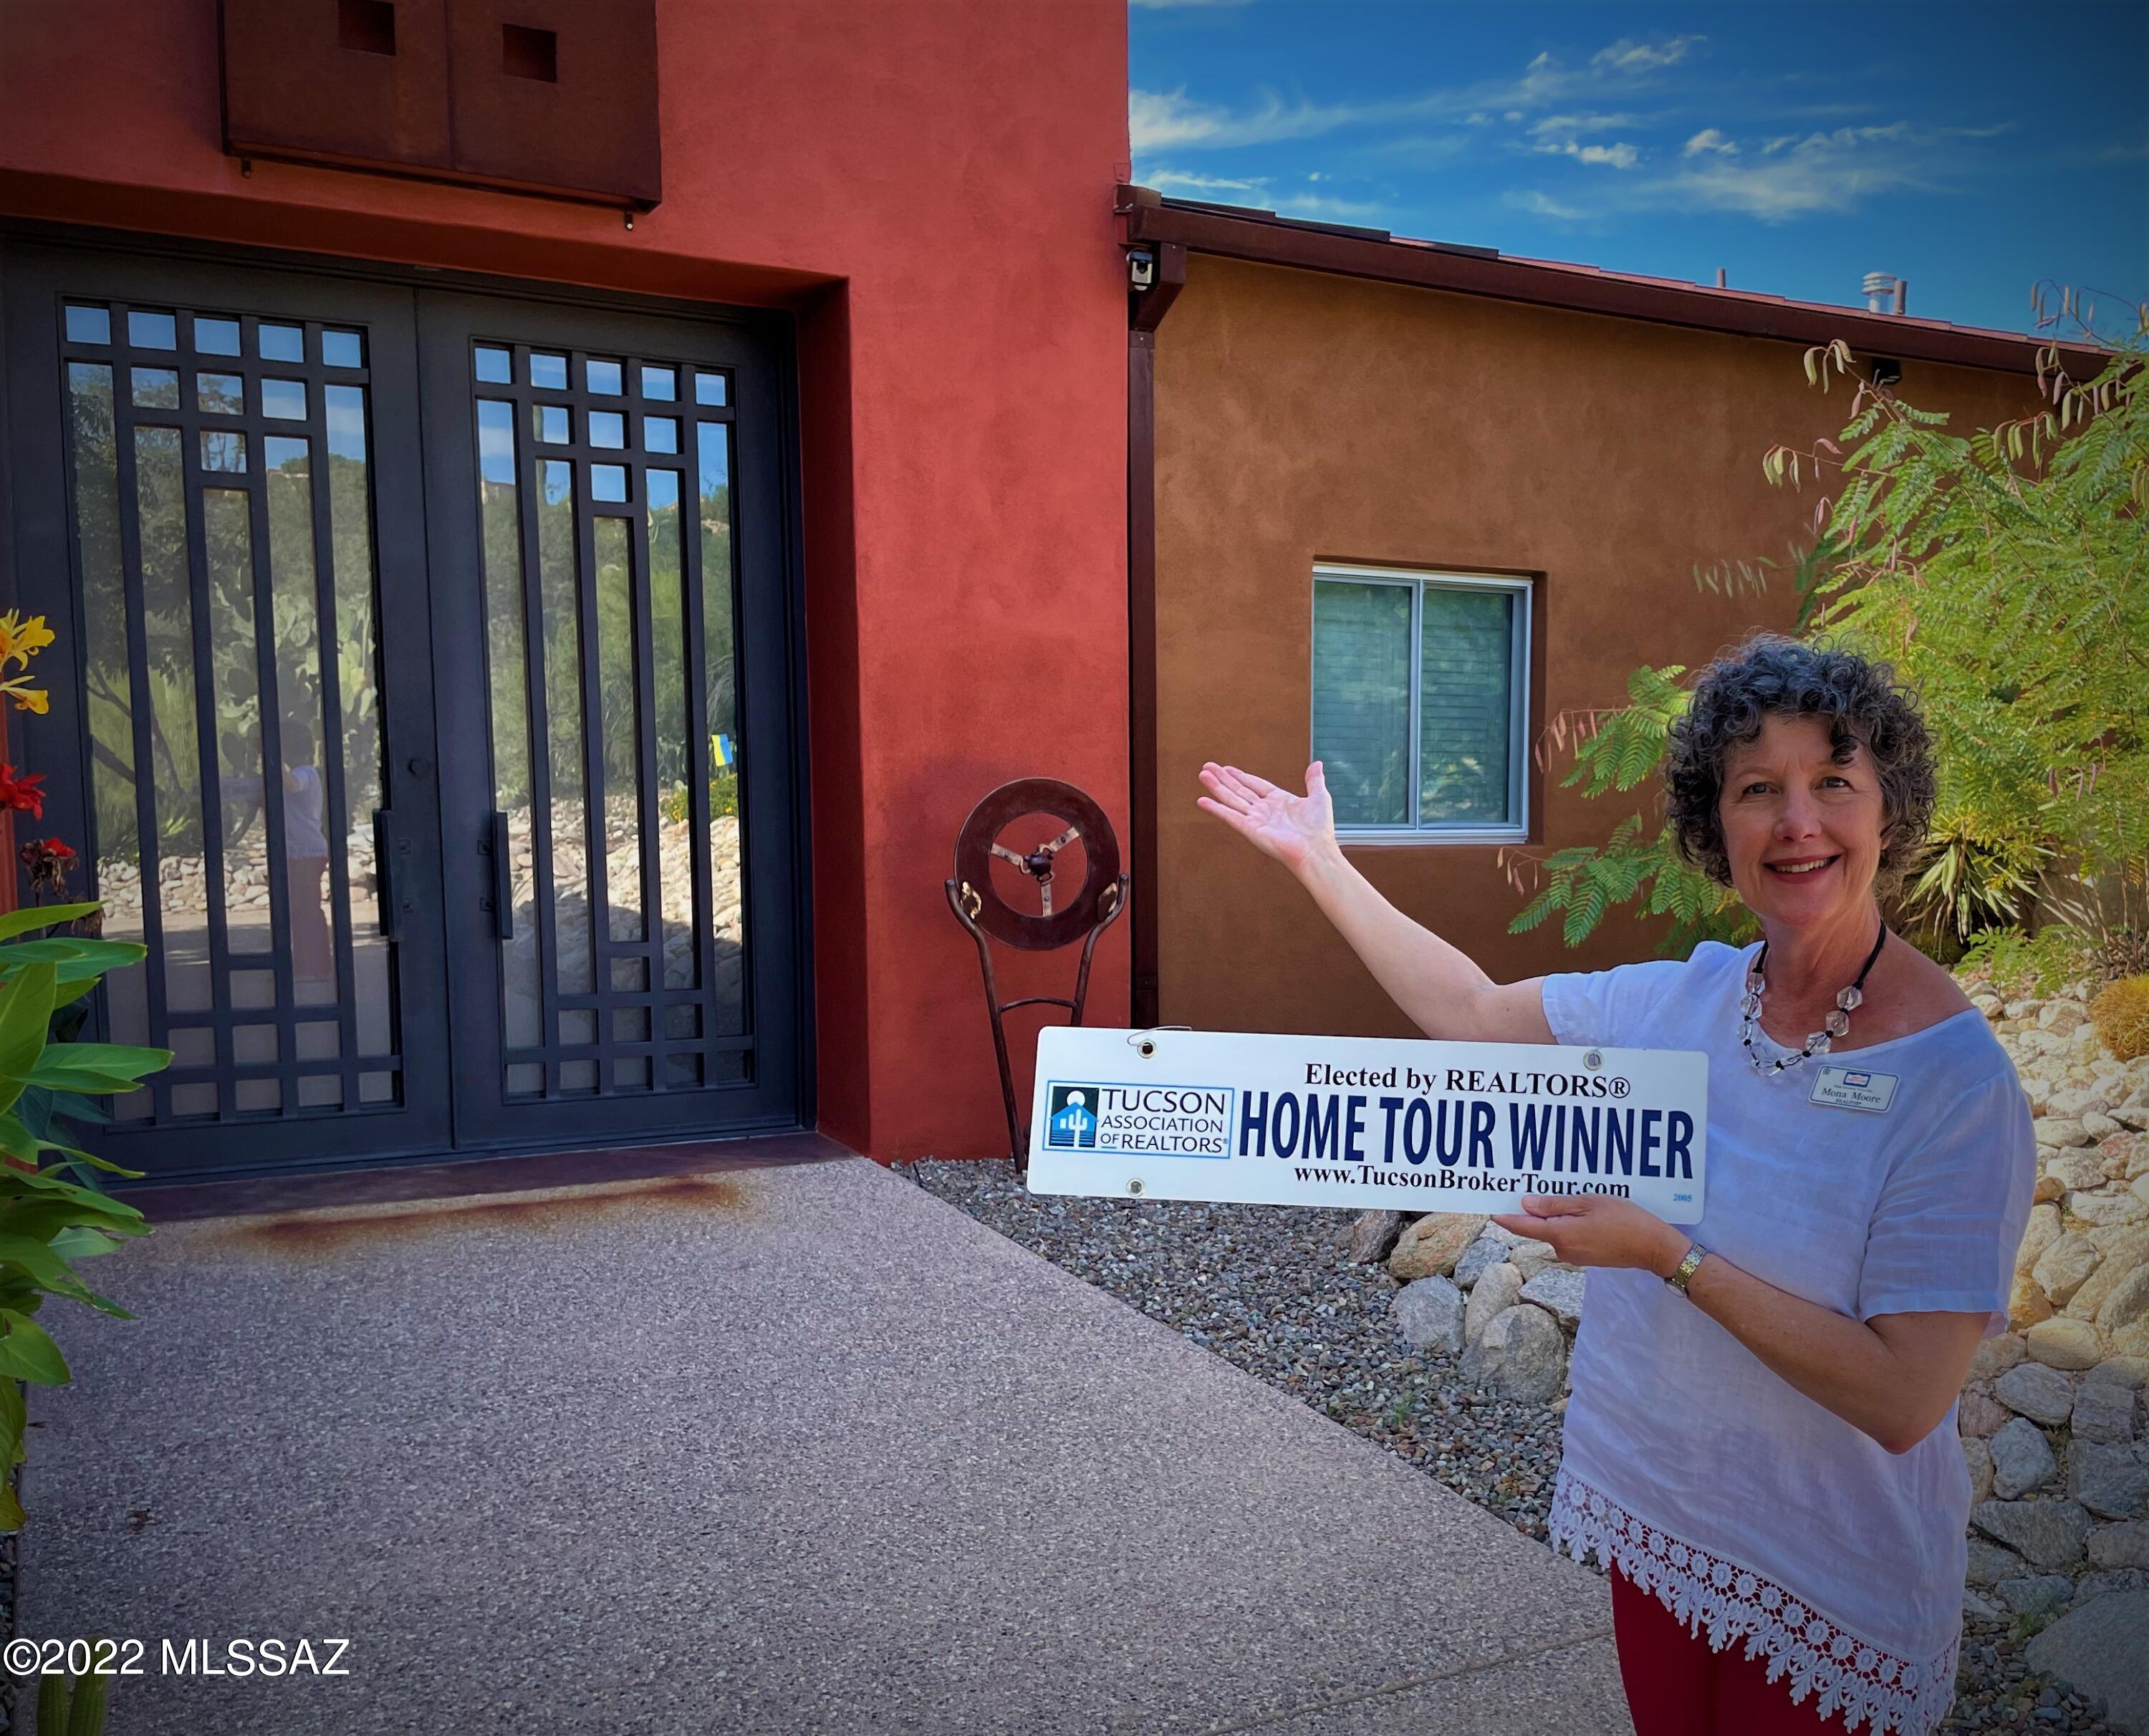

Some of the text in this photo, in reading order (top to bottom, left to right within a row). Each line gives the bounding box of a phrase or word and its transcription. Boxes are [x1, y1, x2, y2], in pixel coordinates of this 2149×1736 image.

[1304, 1063, 1631, 1099] Elected by REALTORS®
[1101, 1088, 1225, 1115] TUCSON
[1822, 1087, 1847, 1098] Mona
[1852, 1092, 1881, 1104] Moore
[1101, 1115, 1223, 1133] ASSOCIATION
[1239, 1090, 1693, 1180] HOME TOUR WINNER
[1100, 1133, 1120, 1144] OF
[1294, 1165, 1630, 1199] www.TucsonBrokerTour.com
